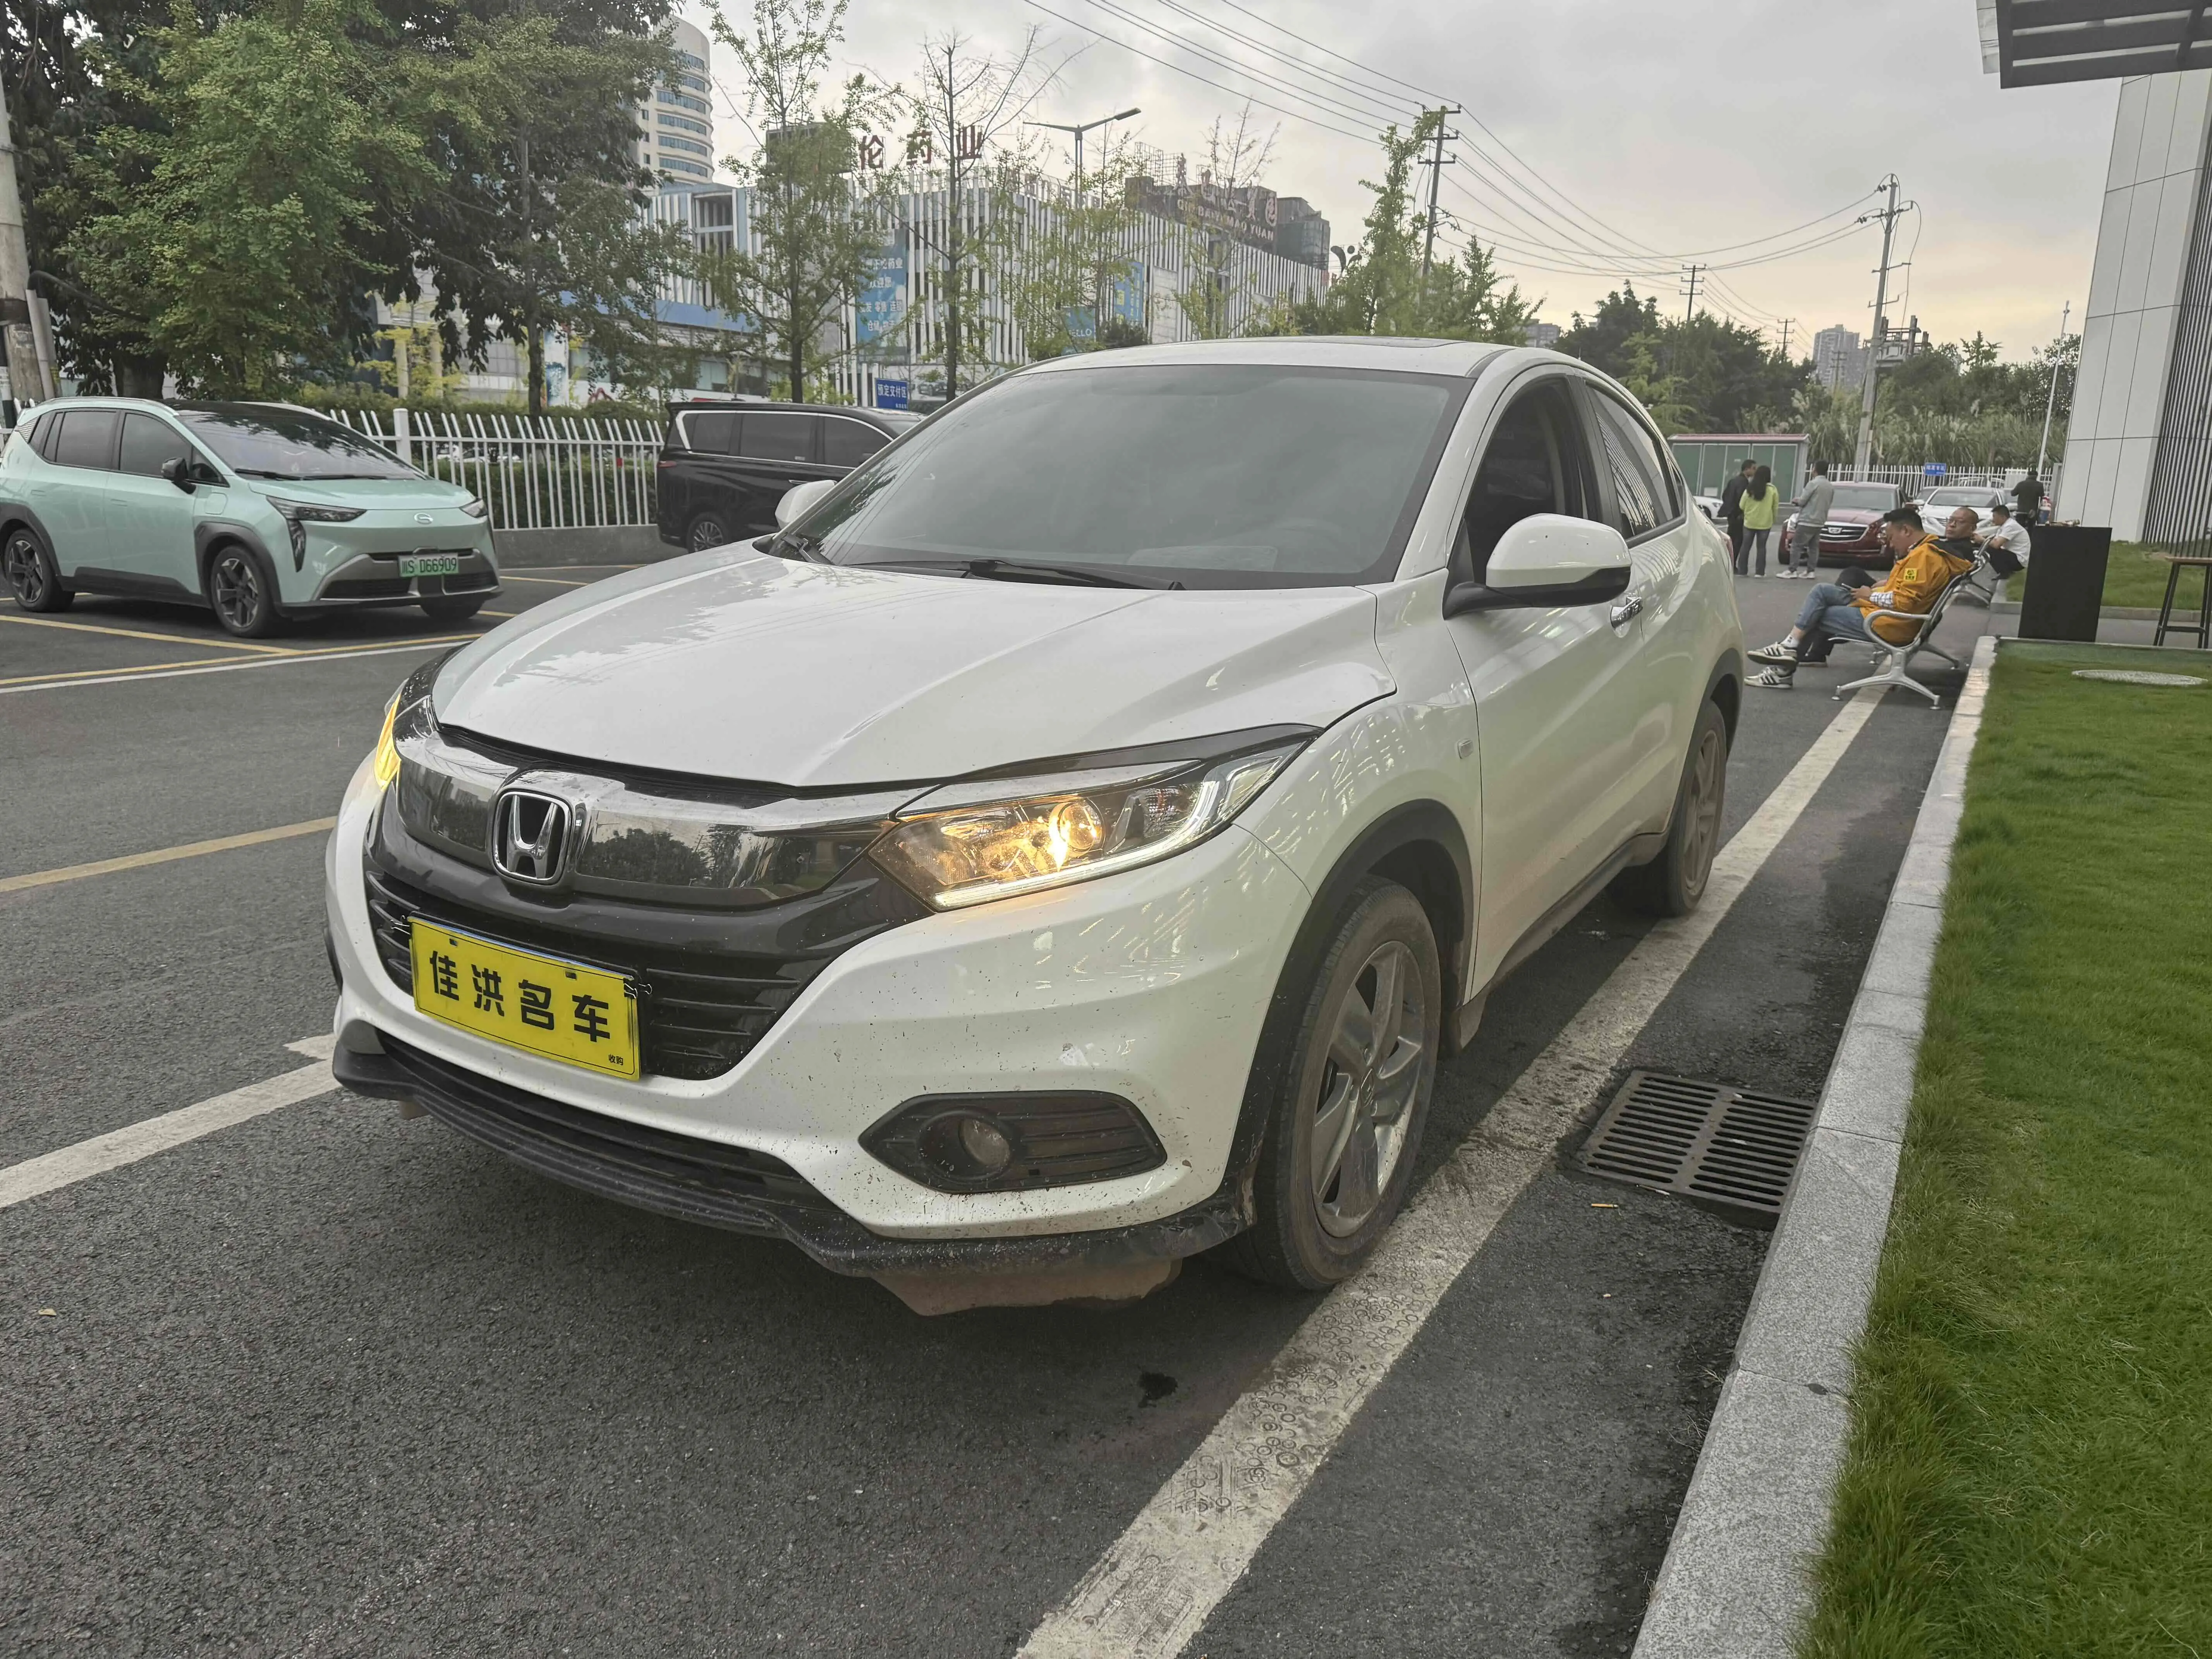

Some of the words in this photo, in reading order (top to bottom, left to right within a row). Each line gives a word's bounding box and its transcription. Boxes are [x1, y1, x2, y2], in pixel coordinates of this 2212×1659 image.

[429, 950, 610, 1042] 佳洪名车
[608, 1054, 623, 1066] 收购
